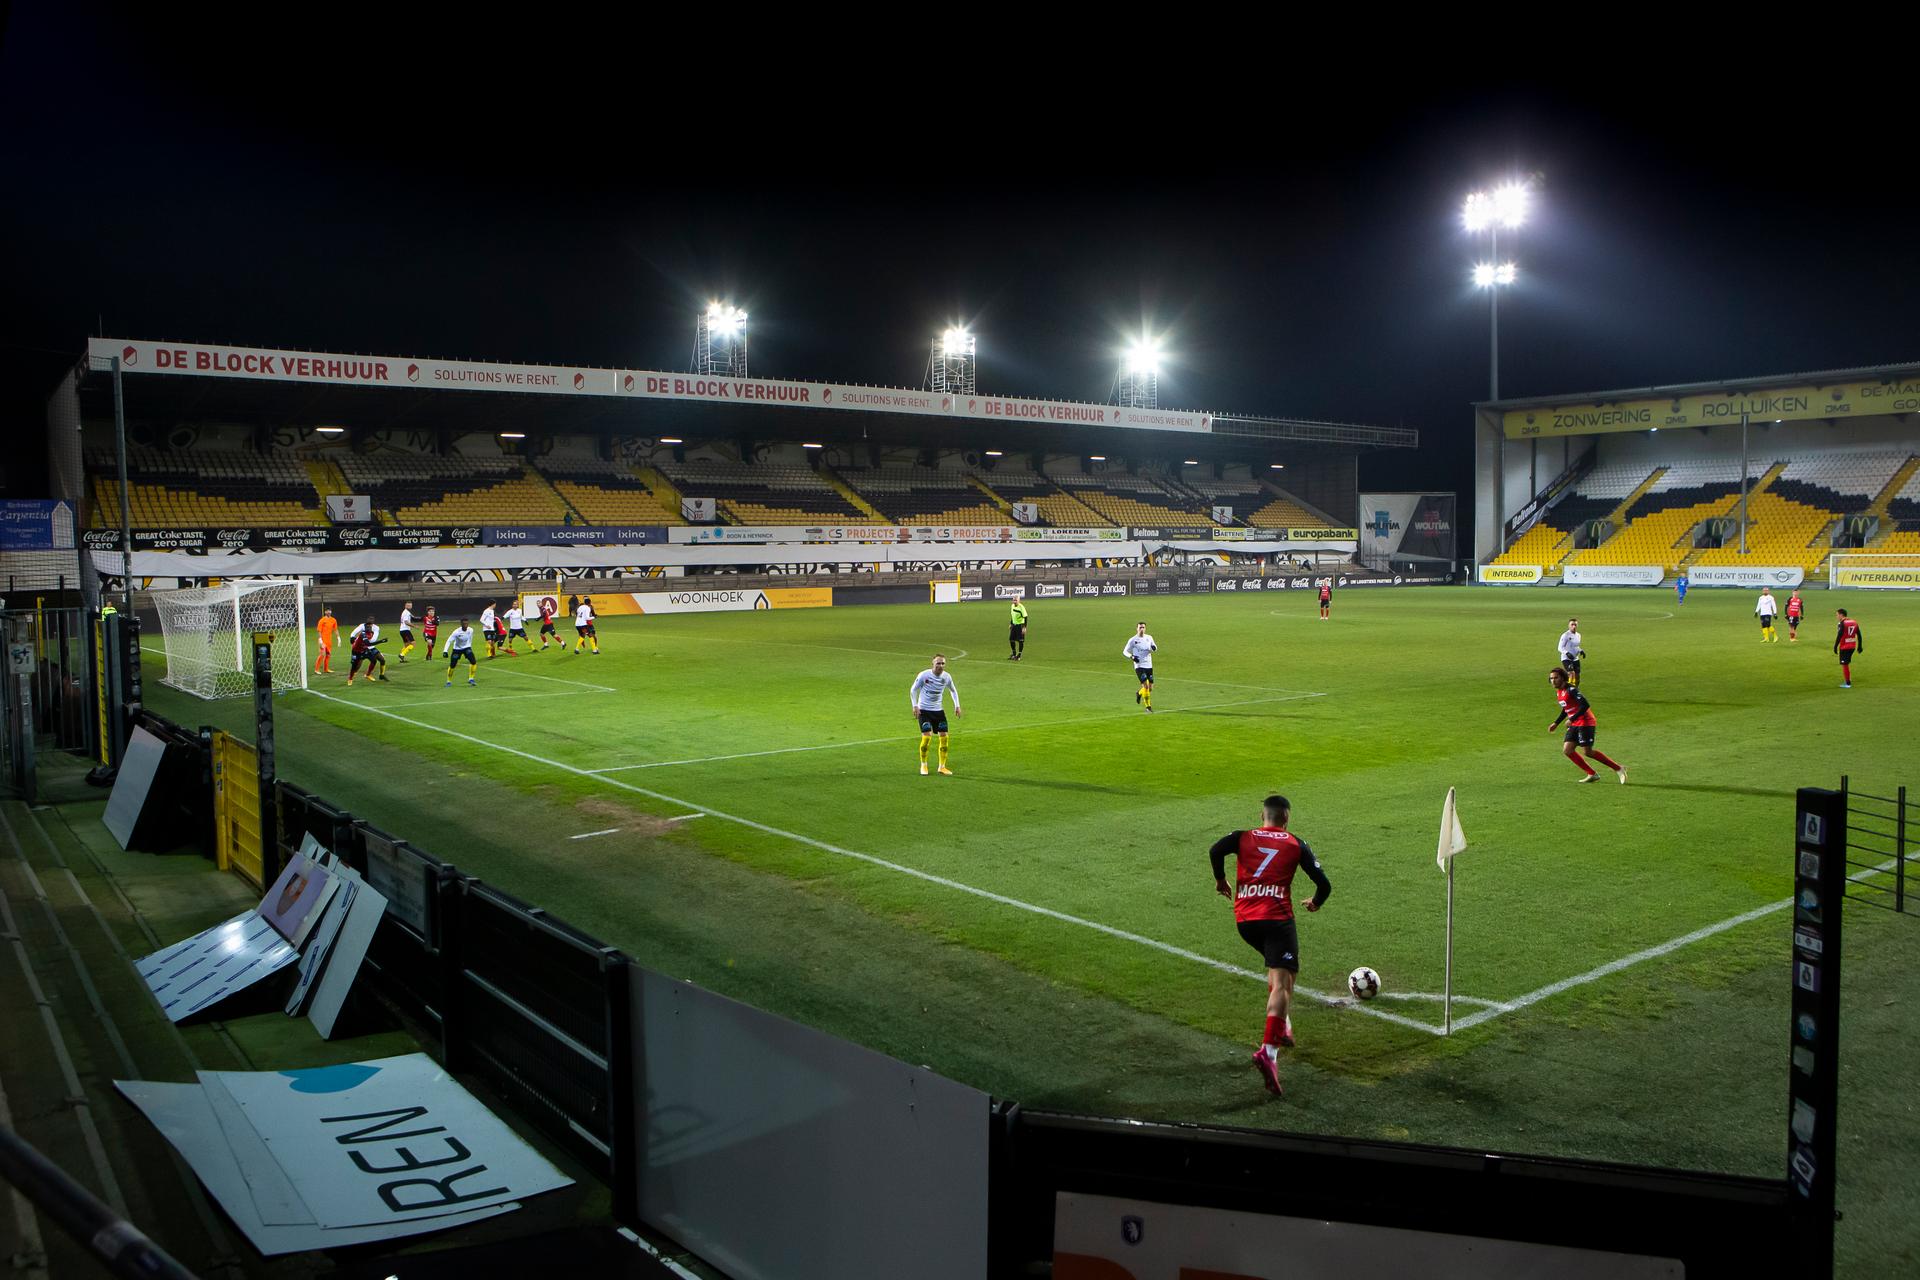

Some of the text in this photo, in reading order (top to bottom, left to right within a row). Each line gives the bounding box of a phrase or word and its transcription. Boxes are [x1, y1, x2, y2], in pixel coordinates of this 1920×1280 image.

[156, 349, 388, 380] DE BLOCK VERHUUR
[434, 369, 559, 386] SOLUTIONS WE RENT.
[647, 377, 810, 402] DE BLOCK VERHUUR
[1861, 386, 1882, 398] DE
[842, 393, 891, 406] SOLUTIONS
[893, 397, 907, 406] WE
[1893, 398, 1920, 410] GO
[986, 402, 1104, 422] DE BLOCK VERHUUR
[1702, 396, 1808, 418] ROLLUIKEN
[1825, 404, 1850, 414] DMG
[1128, 414, 1164, 424] SOLUTIONS
[1166, 417, 1176, 425] WE
[1553, 408, 1651, 428] ZONWERING
[1666, 416, 1687, 424] DMG
[1520, 426, 1540, 434] DMG
[135, 532, 158, 540] GREAT
[159, 530, 182, 539] Coke
[286, 530, 308, 538] Coke
[383, 530, 402, 538] GREAT
[403, 529, 422, 537] Coke
[496, 530, 526, 540] ixina
[618, 530, 646, 539] ixina
[847, 529, 895, 538] PROJECTS
[937, 528, 950, 538] CS
[954, 529, 997, 538] PROJECTS
[1134, 528, 1159, 537] Beltona
[1293, 530, 1354, 539] europabank
[90, 542, 113, 550] zero
[154, 540, 178, 548] zero
[282, 538, 302, 546] zero
[1492, 570, 1534, 578] INTERBAND
[1601, 571, 1653, 579] VERSTRAETEN
[1694, 572, 1764, 580] MINI GENT STORE
[1850, 574, 1912, 582] INTERBAND
[670, 591, 744, 604] WOONHOEK
[960, 588, 982, 598] Jupiler
[1848, 626, 1856, 636] 17
[1252, 846, 1280, 878] 7
[1238, 884, 1285, 899] MOUHLI
[320, 1106, 510, 1213] REN
